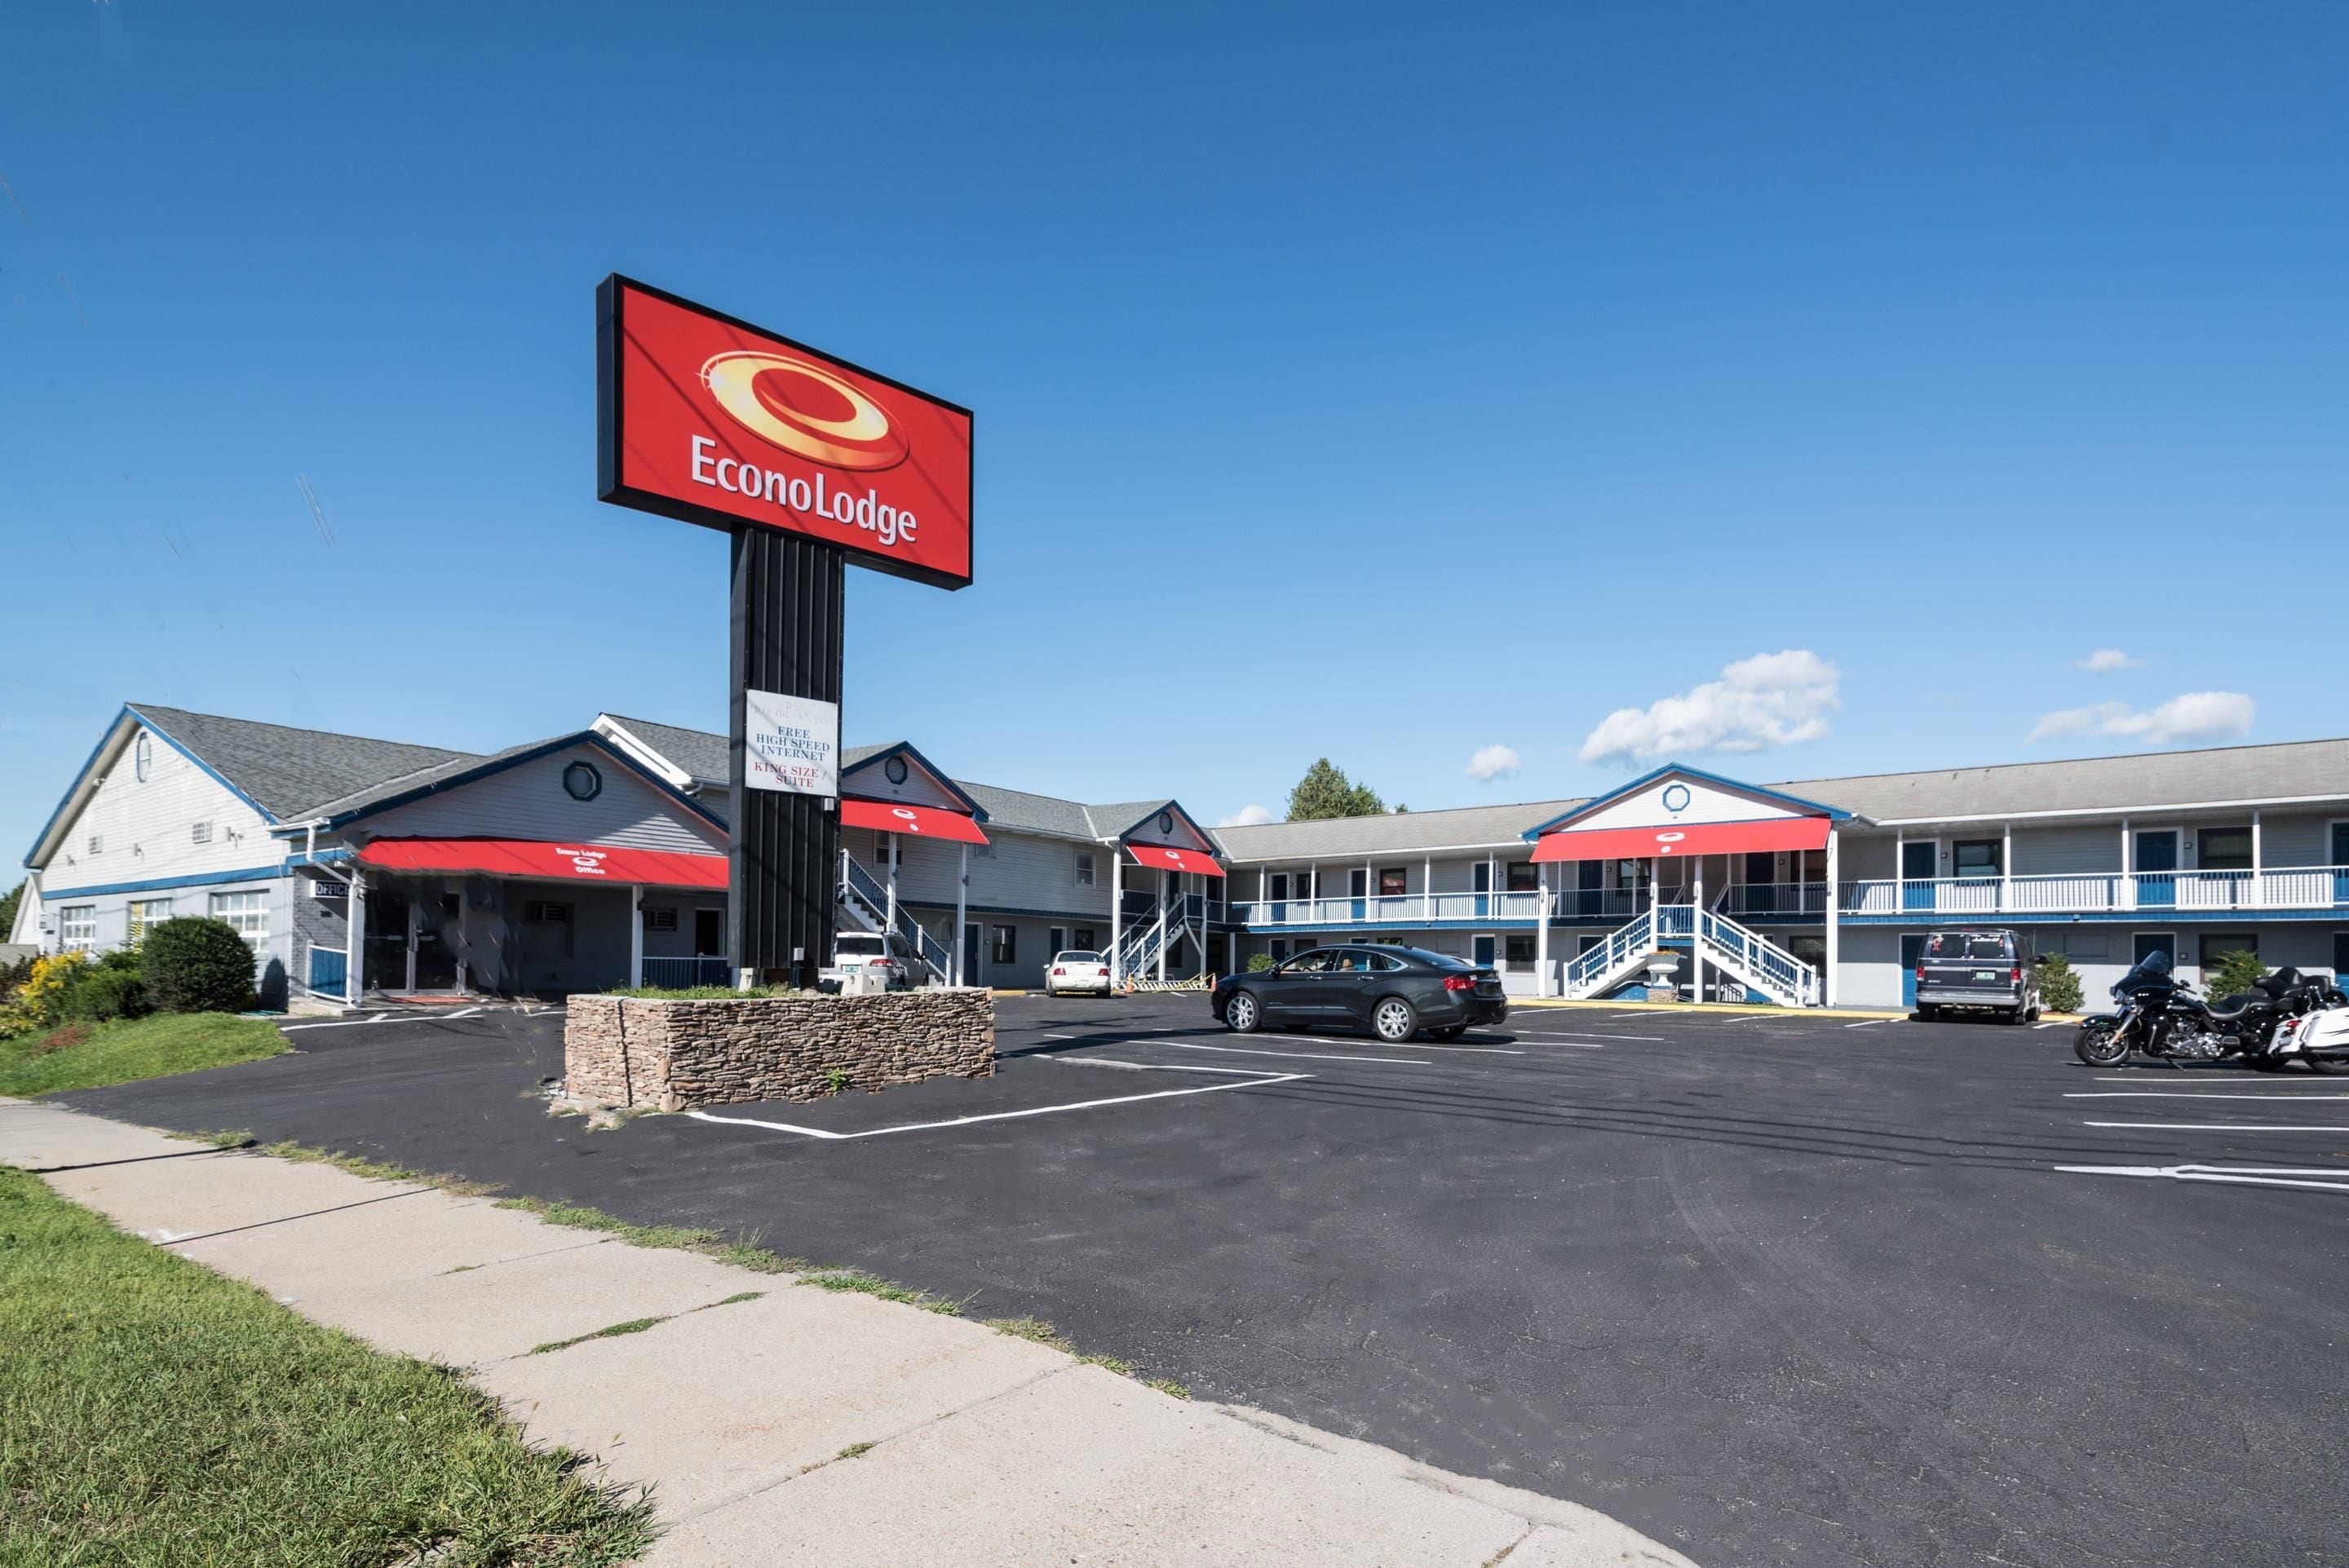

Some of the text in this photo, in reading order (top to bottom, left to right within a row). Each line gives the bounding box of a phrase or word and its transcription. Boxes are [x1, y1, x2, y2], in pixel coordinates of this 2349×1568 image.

[691, 435, 918, 545] EconoLodge
[777, 726, 810, 739] FREE
[756, 733, 830, 752] HIGH SPEED
[761, 744, 825, 762] INTERNET
[754, 762, 819, 778] KING SIZE
[776, 775, 814, 788] SUITE
[575, 866, 605, 875] Office
[316, 882, 349, 895] OFFICE
